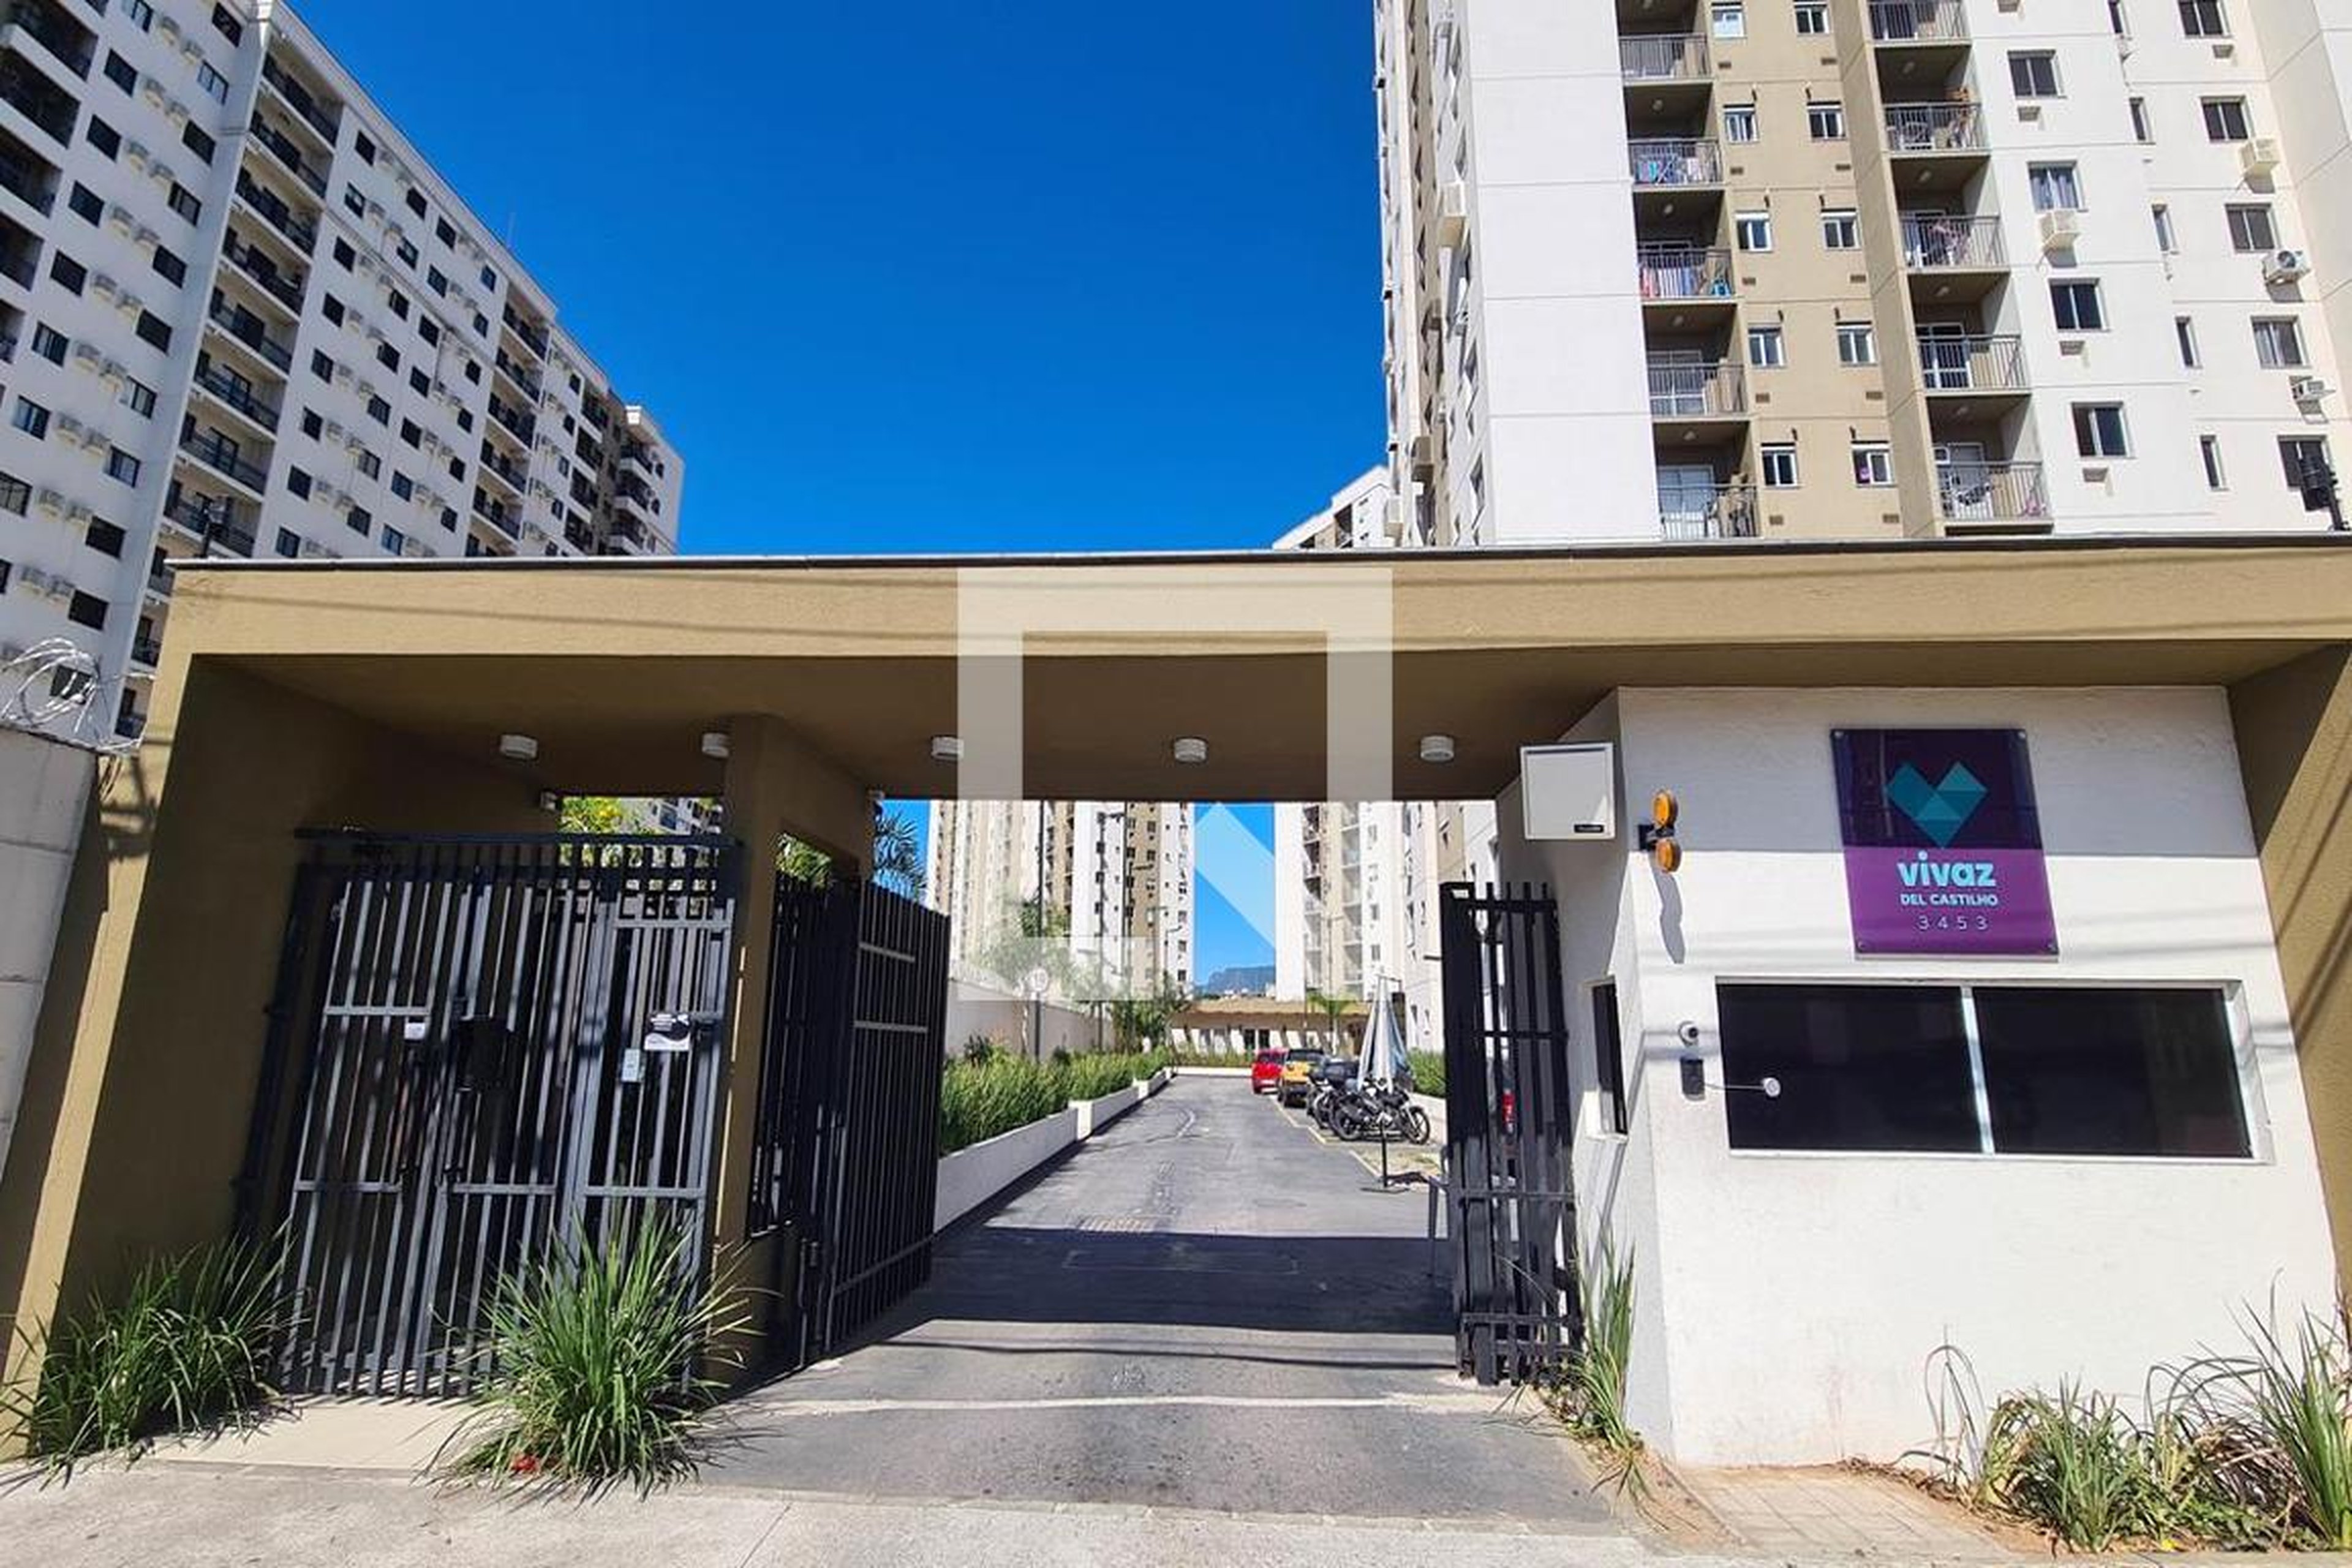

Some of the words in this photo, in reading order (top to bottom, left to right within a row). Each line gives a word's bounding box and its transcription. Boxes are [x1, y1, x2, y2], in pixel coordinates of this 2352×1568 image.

[1896, 850, 1997, 887] vivaz
[1900, 893, 1928, 906] DEL
[1930, 893, 1999, 906] CASTILHO
[1918, 915, 1988, 930] 3453
